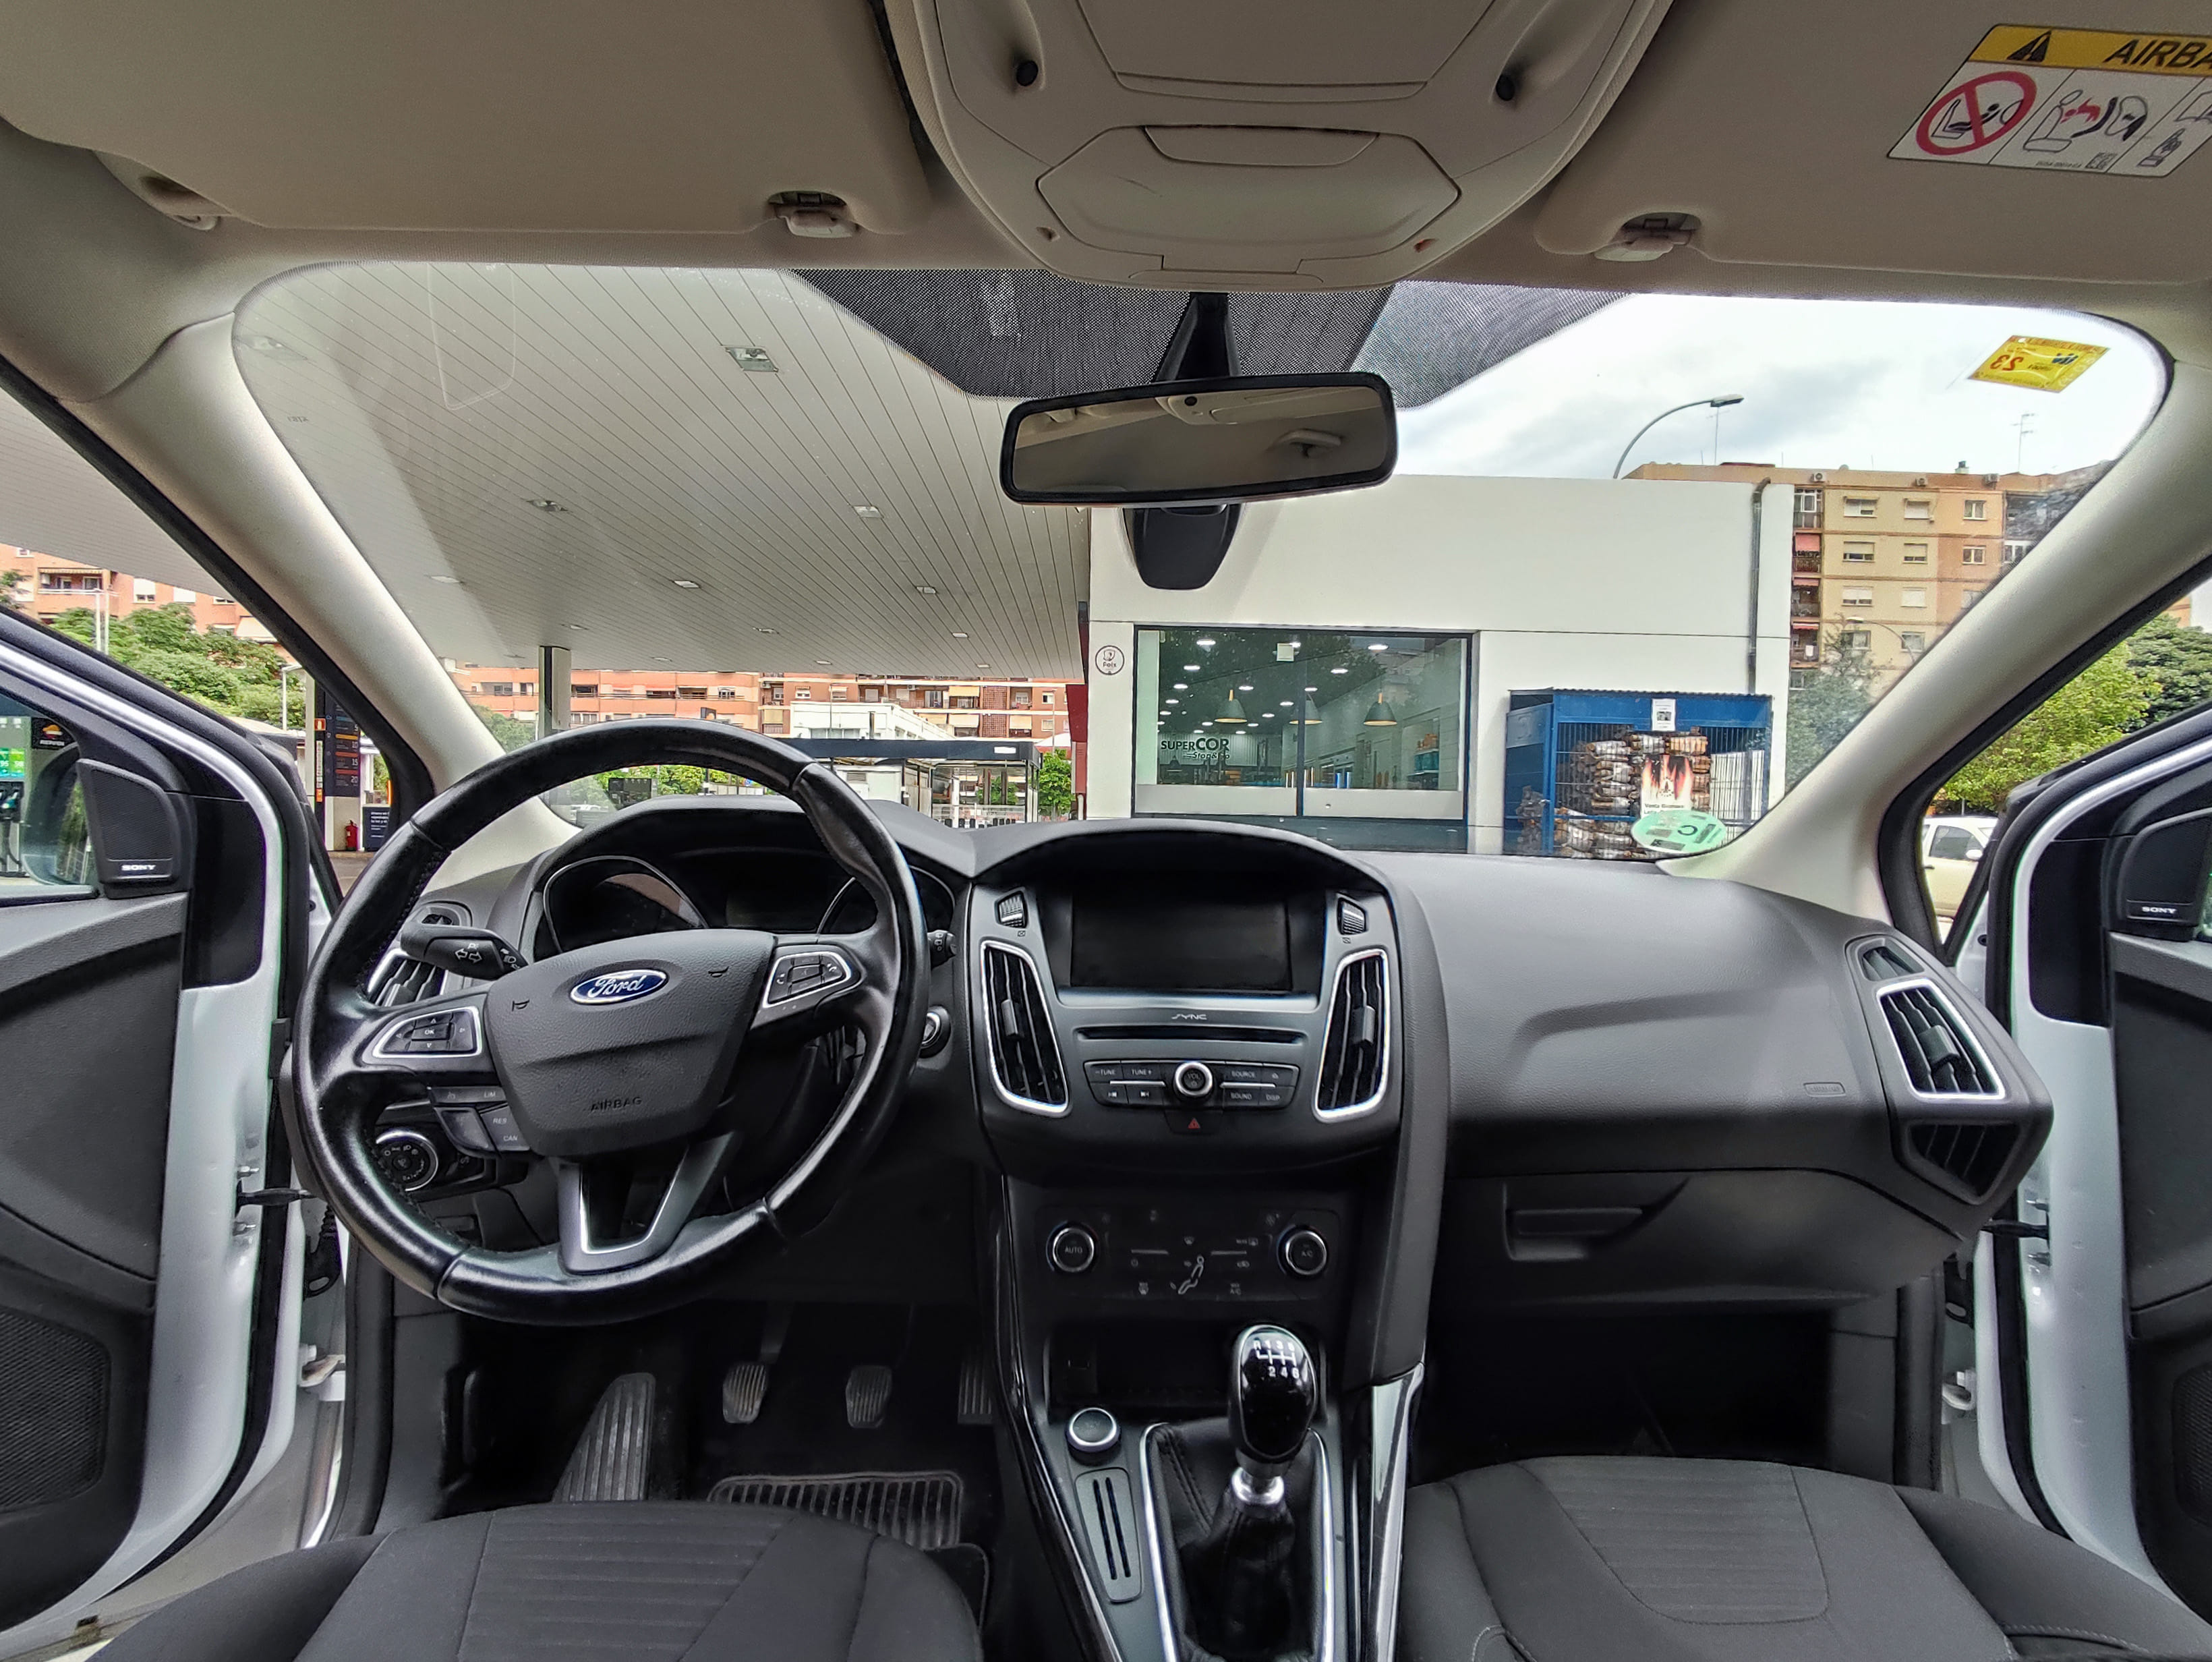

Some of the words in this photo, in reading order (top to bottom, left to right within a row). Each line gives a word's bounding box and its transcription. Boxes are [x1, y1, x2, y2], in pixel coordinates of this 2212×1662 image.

[1161, 738, 1229, 751] SUPERCOR
[591, 1096, 642, 1112] AIRBAG
[1254, 1340, 1261, 1350] R
[1264, 1340, 1271, 1349] 1
[1276, 1340, 1283, 1350] 3
[1269, 1366, 1276, 1377] 2
[1281, 1367, 1288, 1378] 4
[1292, 1367, 1300, 1379] 6
